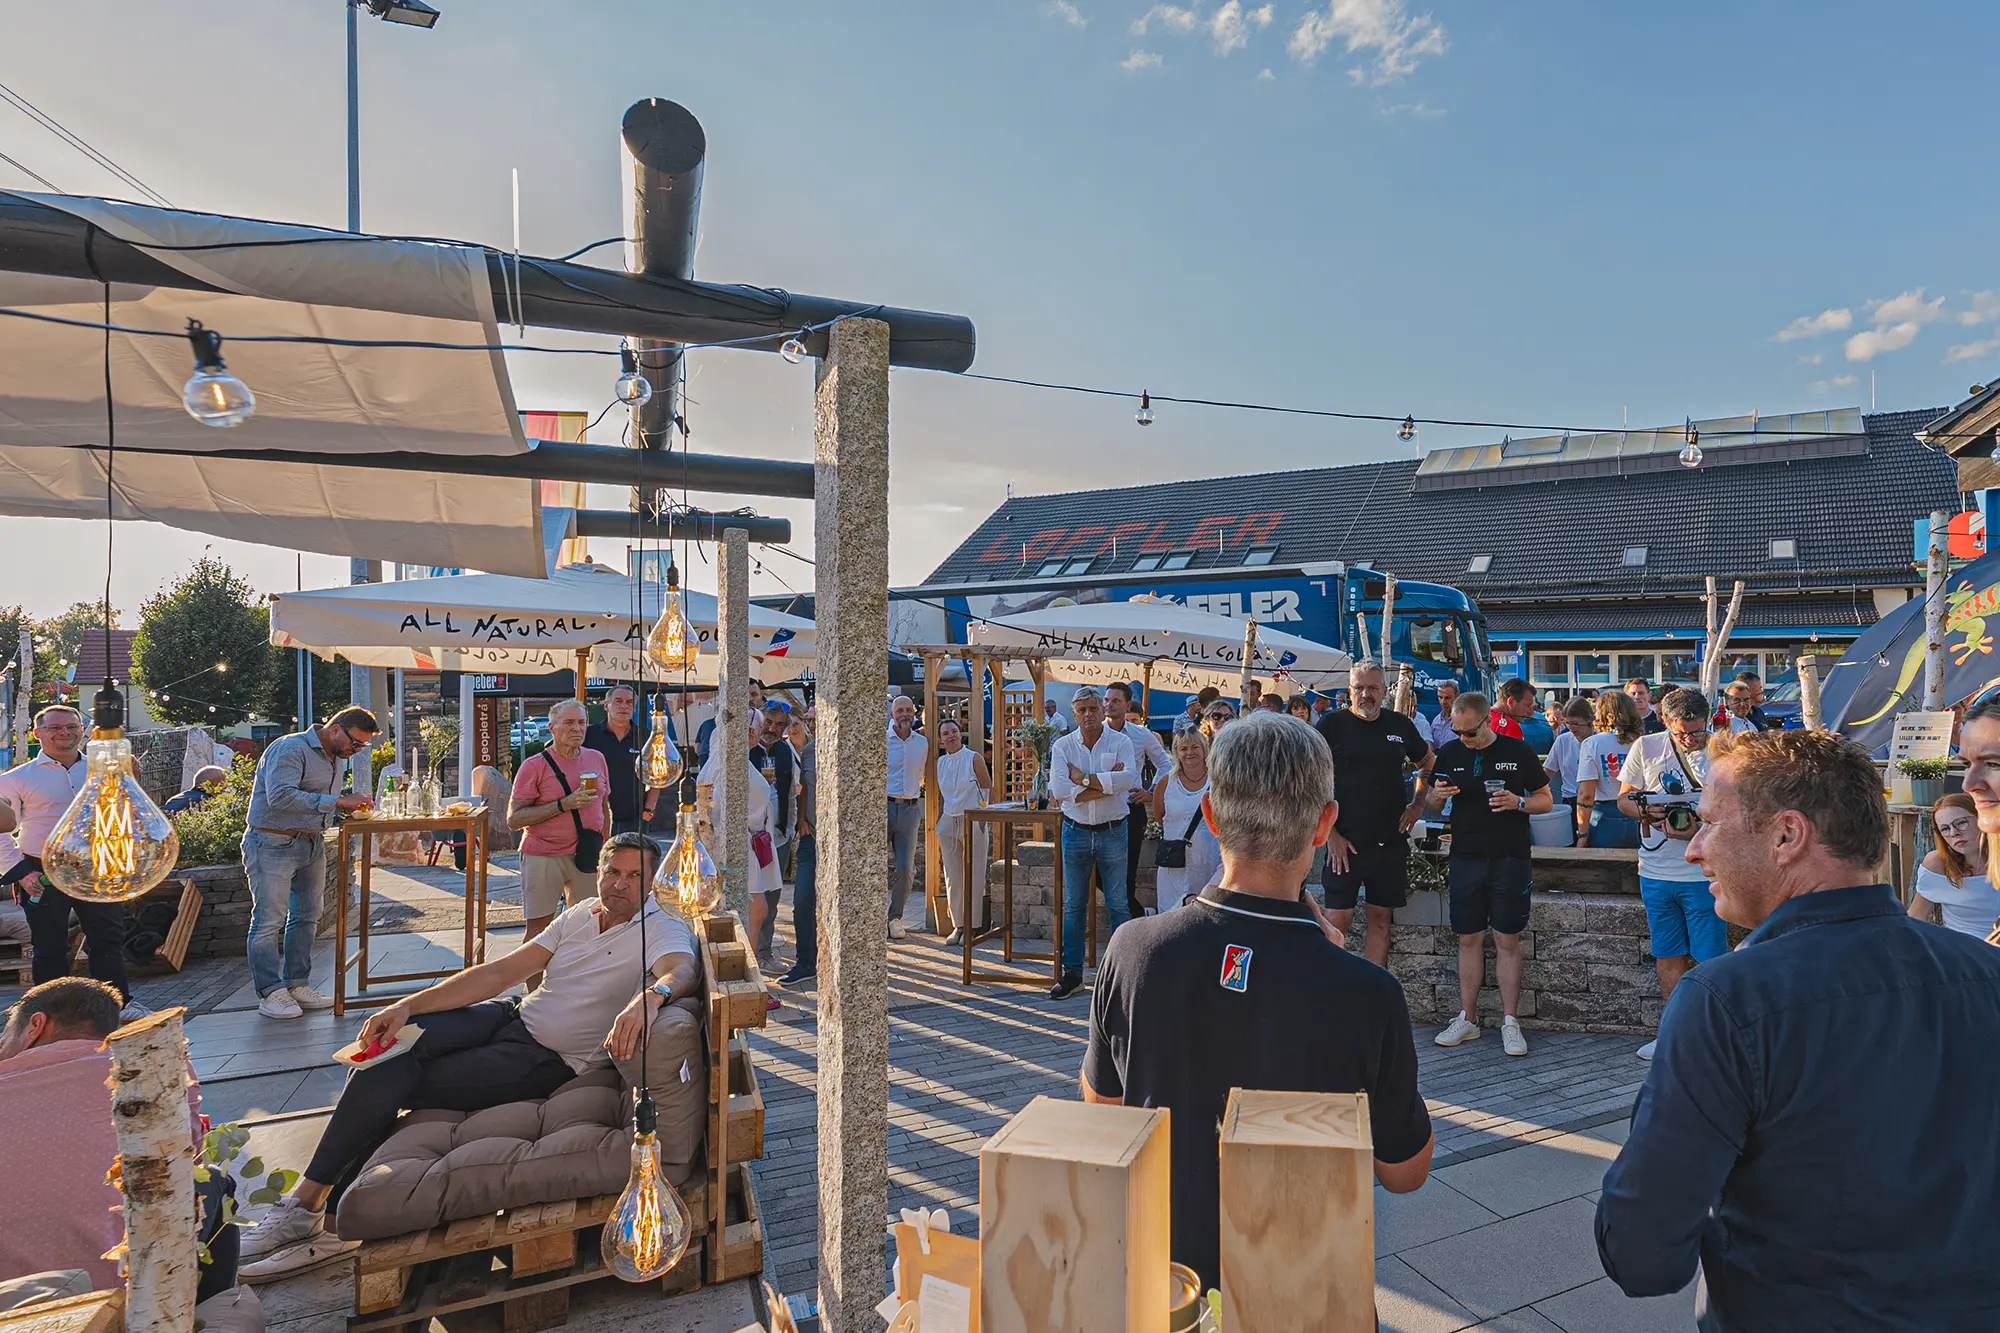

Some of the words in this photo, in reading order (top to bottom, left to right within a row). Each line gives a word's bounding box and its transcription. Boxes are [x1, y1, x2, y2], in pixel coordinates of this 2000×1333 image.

[400, 608, 461, 633] ALL
[1037, 629, 1073, 650] ALL
[1174, 641, 1210, 659] ALL
[474, 673, 497, 690] eber
